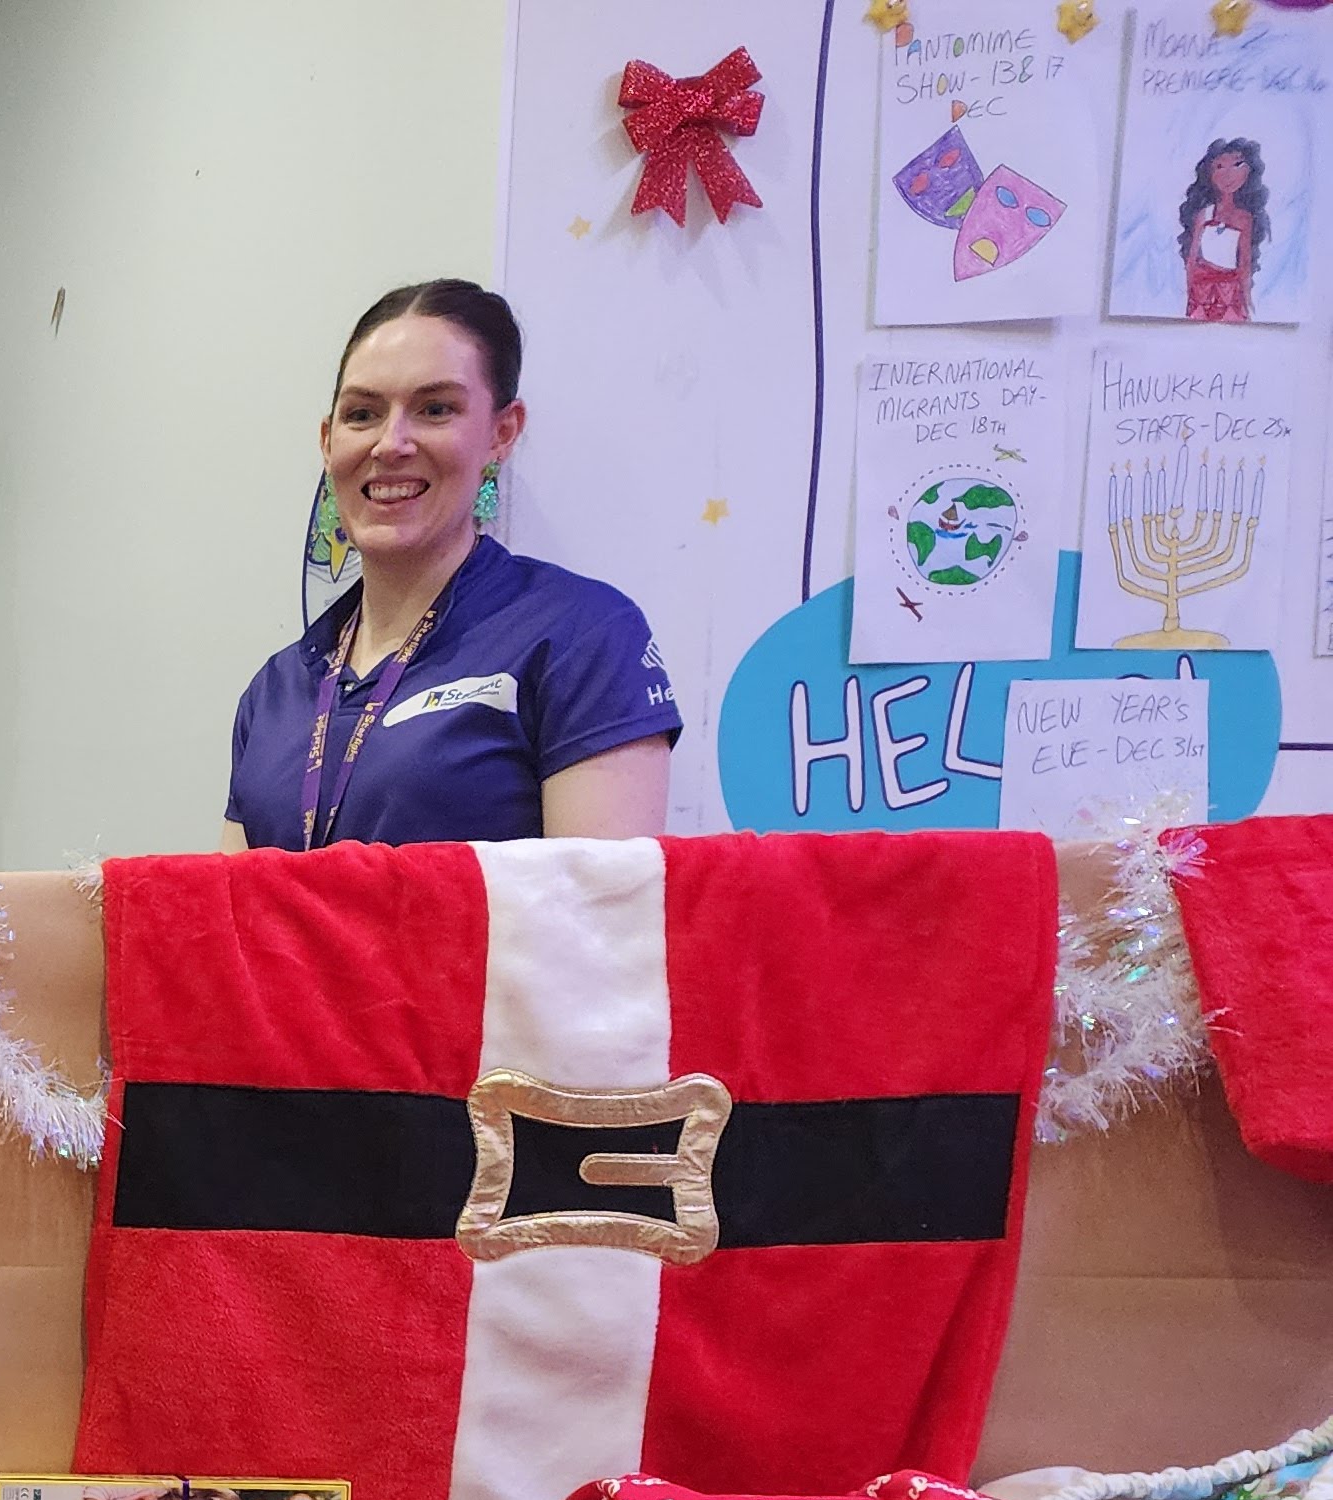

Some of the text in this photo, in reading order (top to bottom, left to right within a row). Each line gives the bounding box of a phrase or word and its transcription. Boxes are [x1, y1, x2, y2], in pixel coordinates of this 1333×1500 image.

[895, 22, 1036, 66] PANTOMIME
[1045, 56, 1065, 80] 17
[951, 96, 1008, 123] DEC
[869, 358, 1044, 391] INTERNATIONAL
[1103, 360, 1250, 411] HANUKKAH
[876, 392, 981, 425] MIGRANTS
[916, 422, 958, 443] DEC
[1016, 697, 1083, 734] NEW
[789, 655, 1003, 816] HEL
